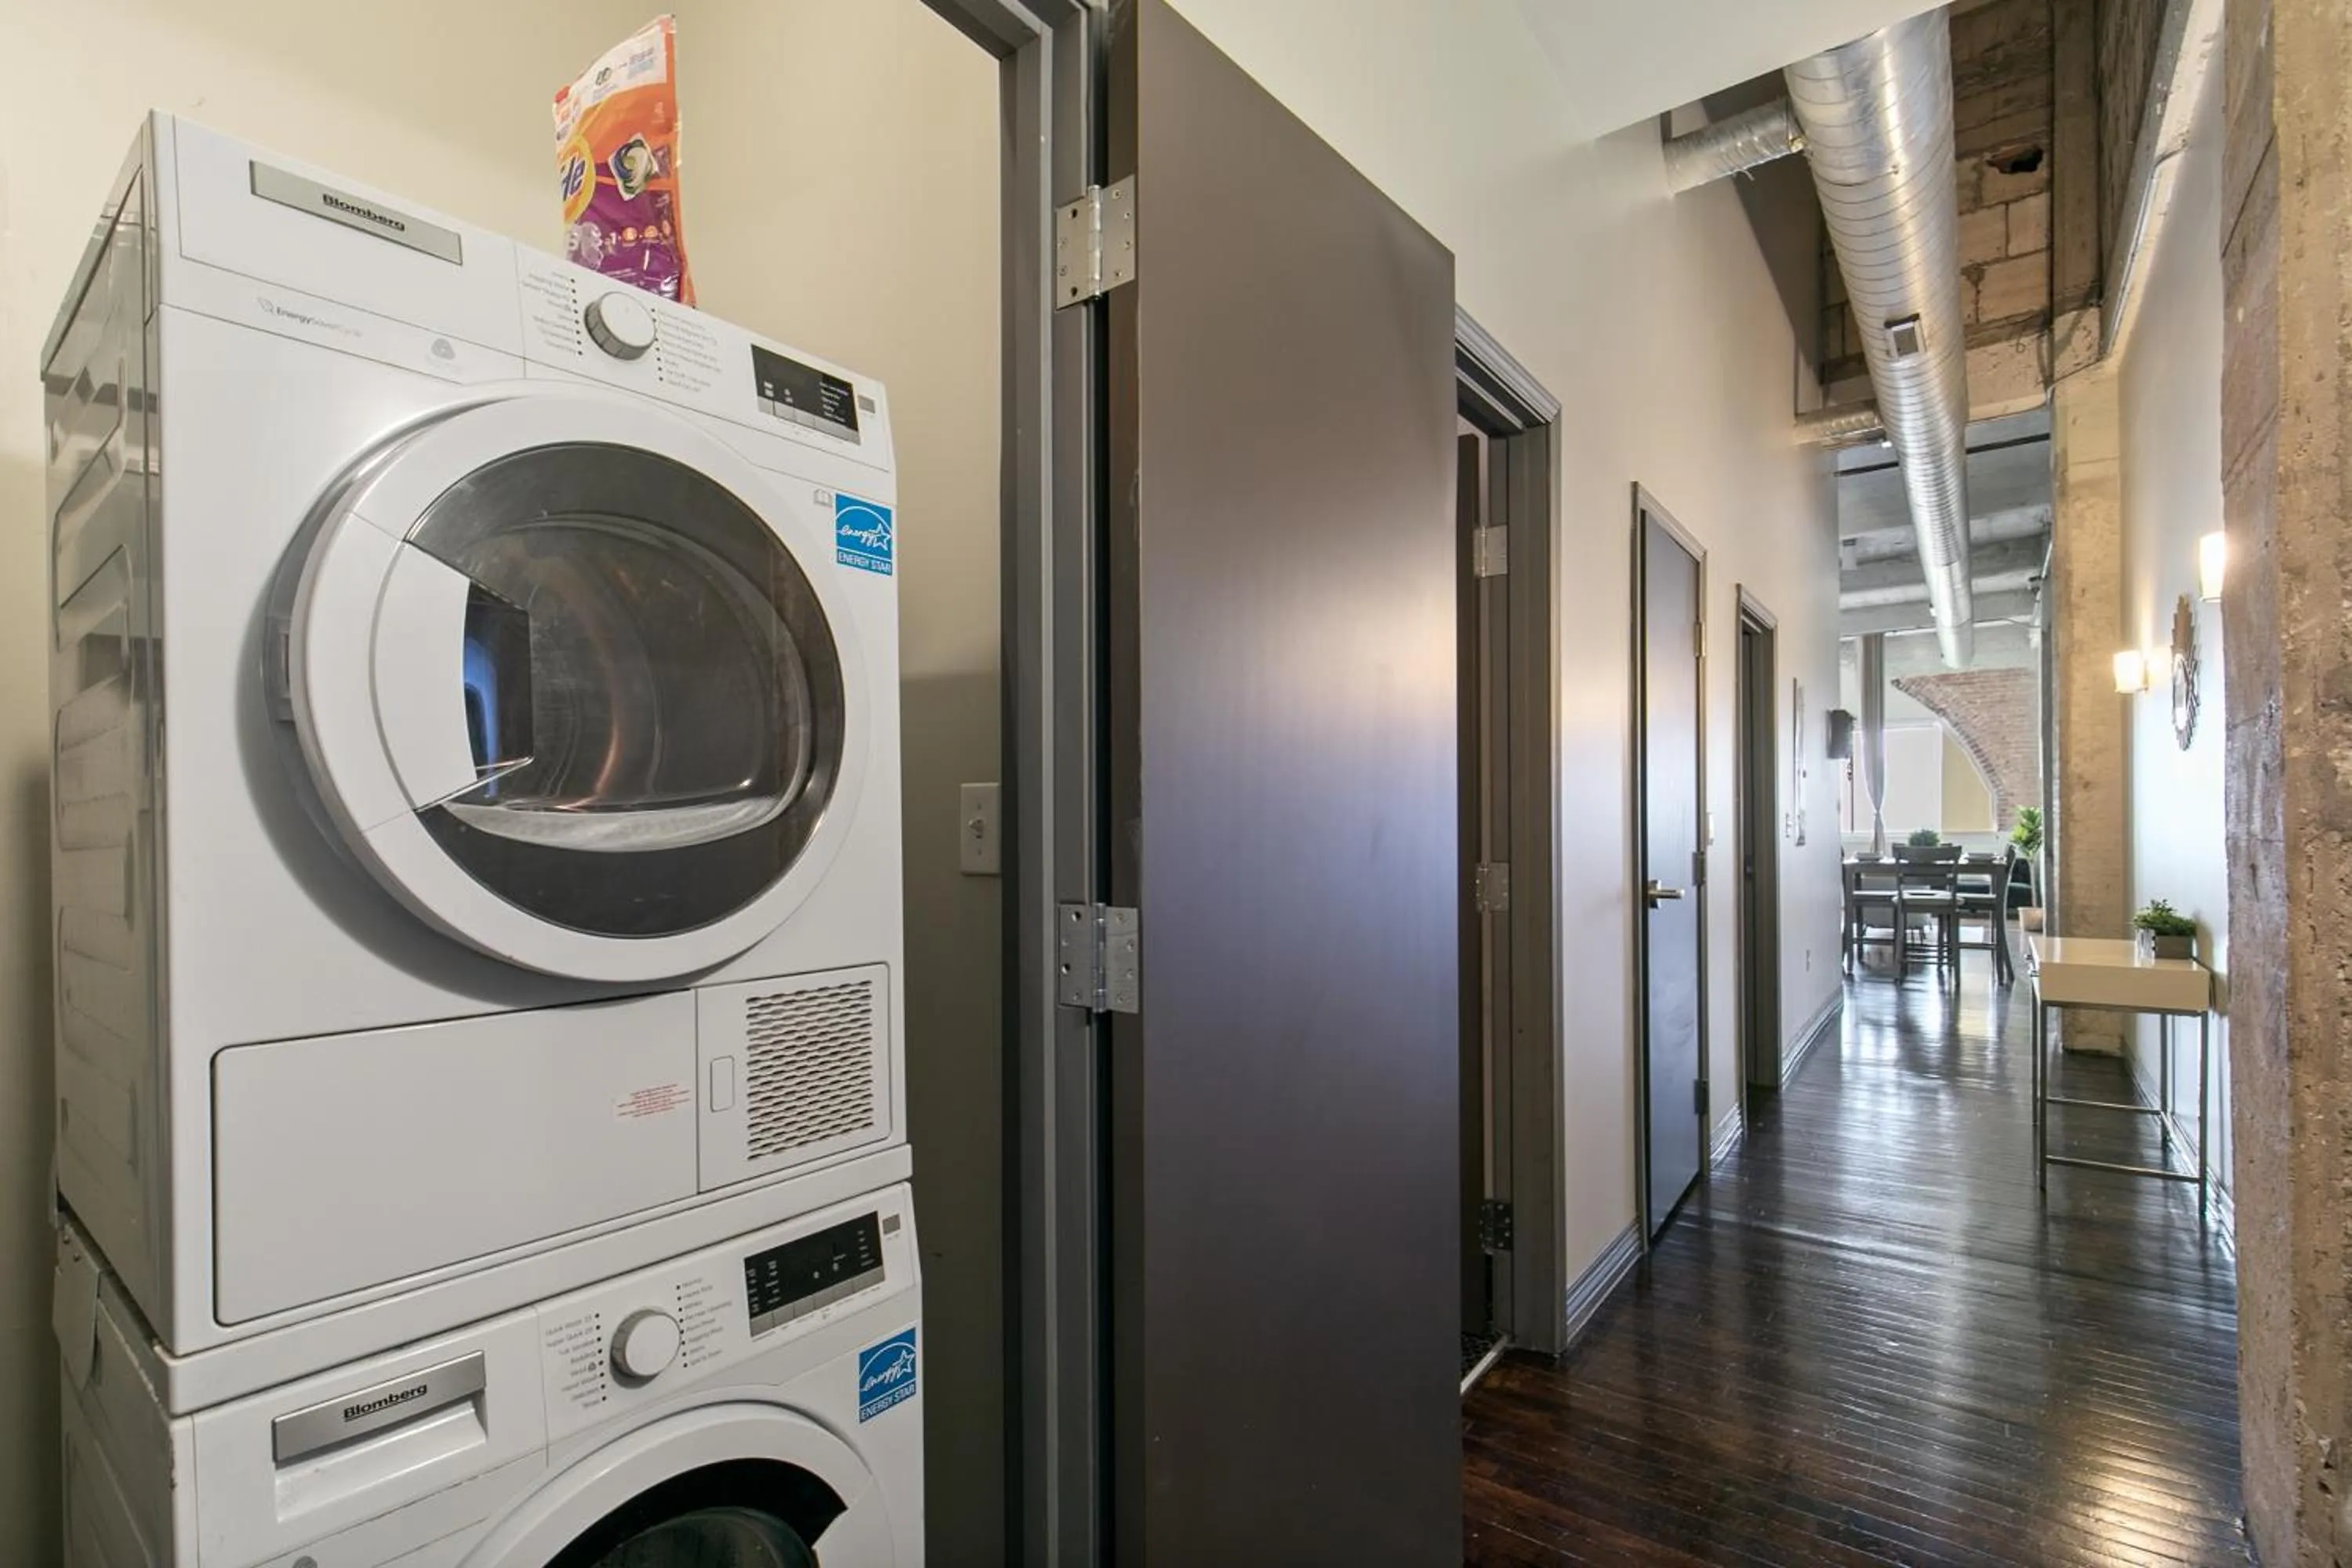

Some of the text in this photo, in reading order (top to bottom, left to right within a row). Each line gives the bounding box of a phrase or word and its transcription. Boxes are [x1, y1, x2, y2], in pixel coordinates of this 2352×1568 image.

[322, 193, 405, 232] Blomberg
[838, 551, 891, 573] ENERGY STAR
[343, 1384, 428, 1422] Blomberg
[861, 1384, 916, 1420] ENERGY STAR
